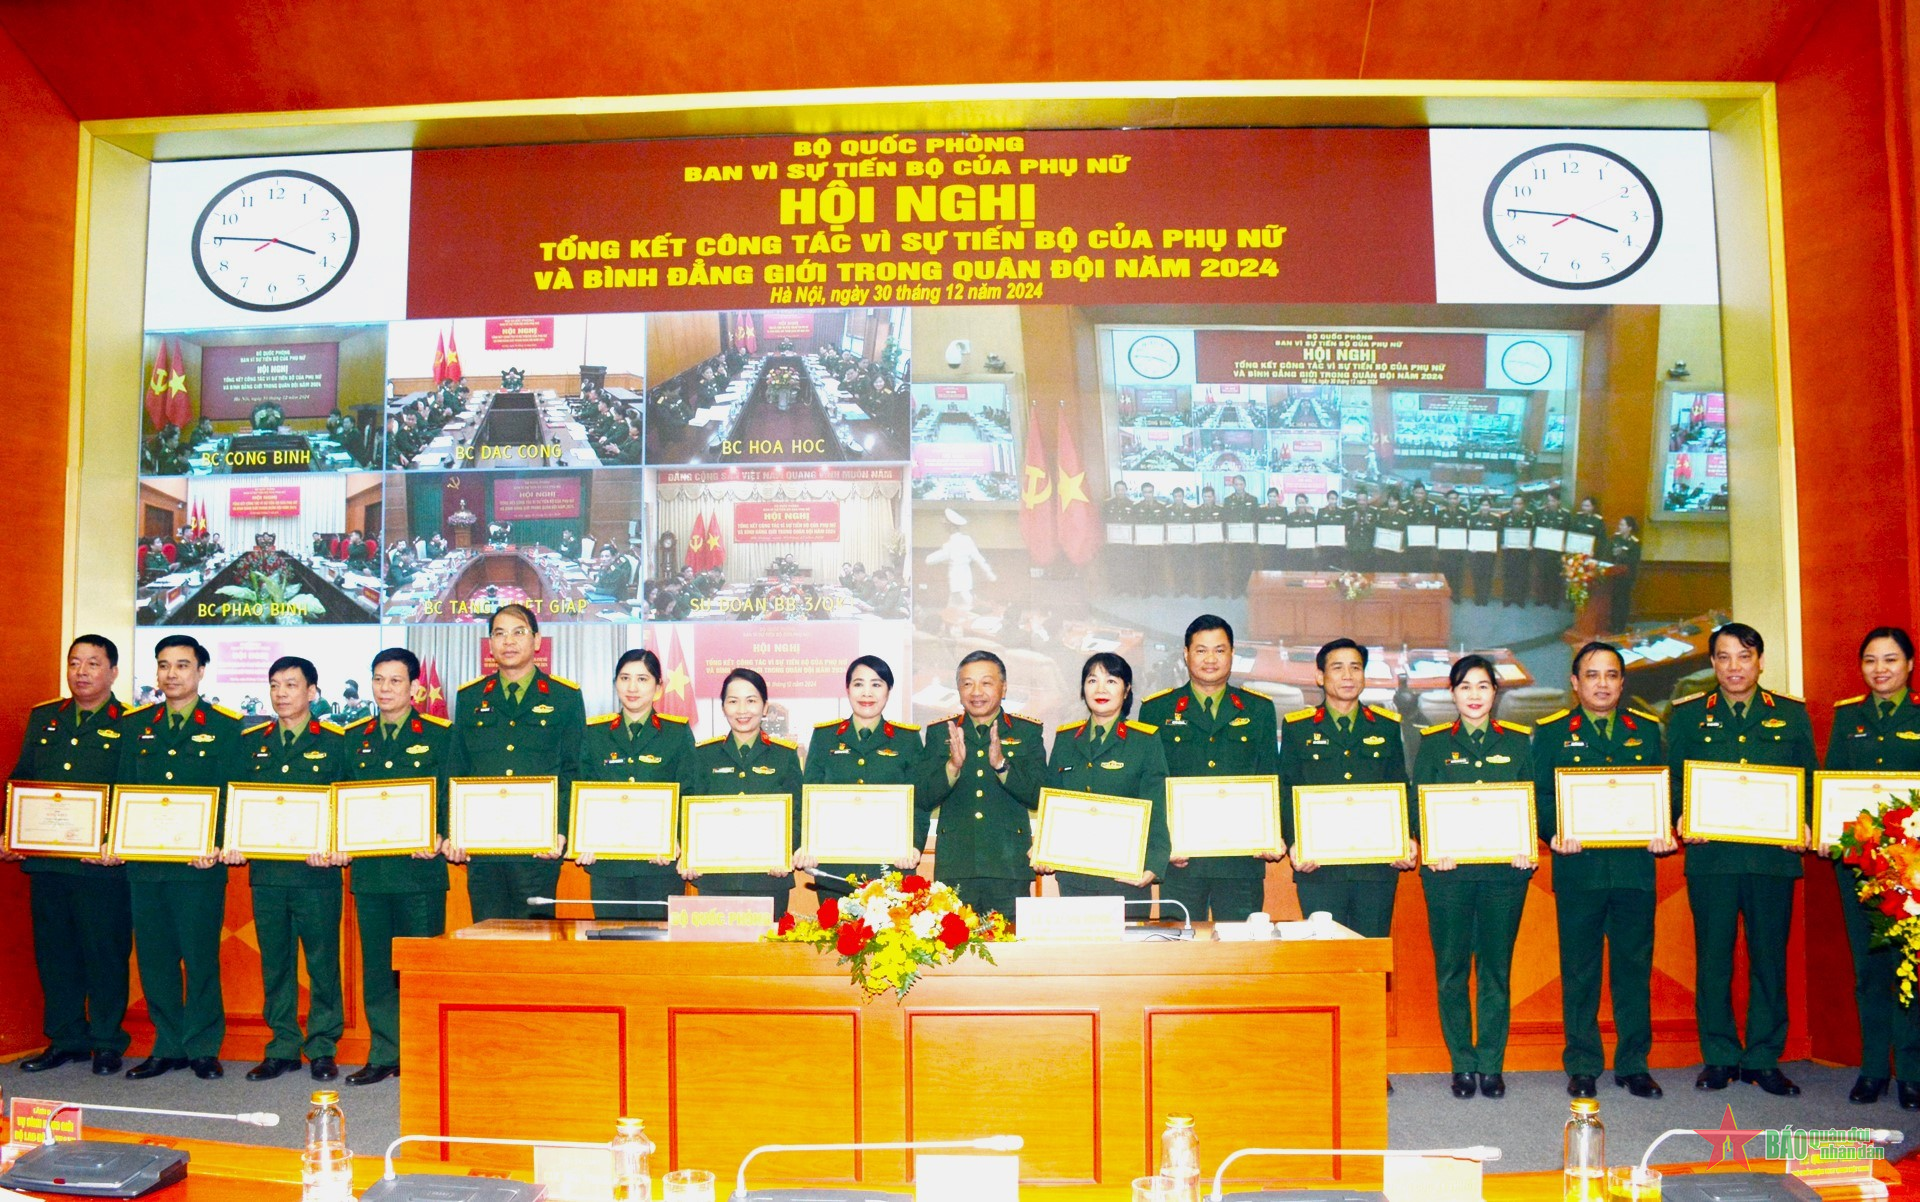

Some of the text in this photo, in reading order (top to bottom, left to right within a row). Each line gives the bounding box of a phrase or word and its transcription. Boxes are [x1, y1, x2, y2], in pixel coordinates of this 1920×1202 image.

[794, 134, 1024, 158] BỘ QUỐC PHÒNG
[685, 154, 1131, 181] BAN VÌ SỰ TIẾN BỘ CỦA PHỤ NỮ
[1562, 162, 1579, 174] 12
[1534, 169, 1546, 179] 11
[269, 188, 284, 199] 12
[1514, 186, 1531, 197] 10
[1620, 187, 1629, 198] 2
[242, 196, 253, 207] 11
[780, 180, 1035, 232] HỘI NGHỊ
[222, 214, 238, 224] 10
[321, 209, 329, 220] 2
[1630, 210, 1638, 222] 3
[328, 232, 336, 243] 3
[540, 222, 1287, 261] TỔNG KẾT CÔNG TÁC VÌ SỰ TIẾN BỘ CỦA PHỤ NỮ
[1517, 234, 1526, 245] 8
[1623, 235, 1632, 246] 4
[319, 256, 326, 268] 4
[1540, 252, 1549, 263] 7
[1601, 253, 1610, 263] 5
[220, 261, 228, 271] 8
[1571, 259, 1580, 270] 6
[534, 255, 1279, 290] VÀ BÌNH ĐẲNG GIỚI TRONG QUÂN ĐỘI NĂM 2024
[240, 277, 248, 288] 7
[298, 275, 305, 285] 5
[268, 283, 276, 292] 6
[770, 282, 1043, 306] Hà Nội, ngày 30 tháng 12 năm 2024
[1303, 347, 1376, 363] HỘI NGHỊ
[1234, 360, 1258, 369] TỔNG
[1261, 360, 1277, 369] KẾT
[1280, 361, 1305, 369] CÔNG
[1410, 364, 1429, 372] PHỤ
[1233, 370, 1245, 378] VÀ
[1352, 371, 1377, 379] QUÂN
[456, 444, 562, 460] BC DAC CONG
[722, 439, 825, 455] BC HOA HOC
[202, 450, 310, 467] BC CONG BINH
[198, 602, 308, 617] BC PHAO BINH
[424, 601, 442, 614] BC
[450, 600, 491, 614] TANG
[550, 599, 587, 614] GIAP
[690, 598, 710, 611] SU
[719, 597, 766, 612] DOAN
[775, 598, 796, 612] BB
[753, 642, 800, 654] HỘI NGHỊ
[670, 907, 771, 928] BỘ QUỐC PHÒNG
